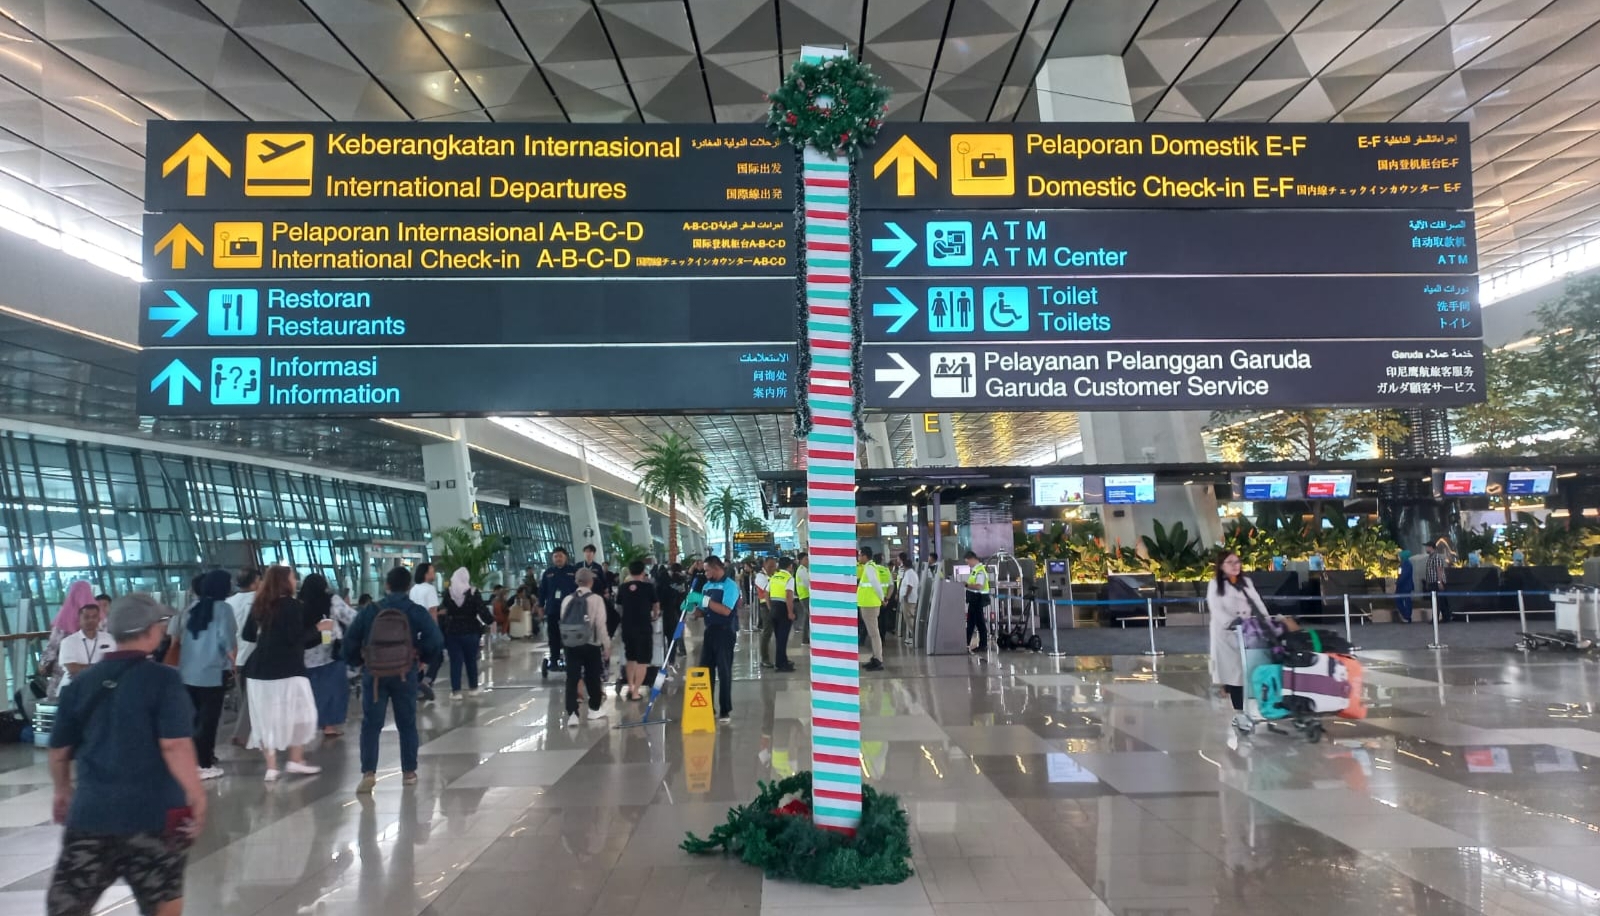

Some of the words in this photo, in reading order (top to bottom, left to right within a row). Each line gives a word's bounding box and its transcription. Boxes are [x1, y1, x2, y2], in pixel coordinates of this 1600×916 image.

[328, 133, 514, 160] Keberangkatan
[525, 135, 680, 158] Internasional
[1027, 134, 1142, 159] Pelaporan
[1151, 134, 1259, 156] Domestik
[1266, 136, 1307, 156] E-F
[1358, 136, 1381, 148] E-F
[737, 163, 781, 174] 国际出发
[327, 175, 480, 197] International
[490, 177, 626, 203] Departures
[727, 188, 782, 200] 国際線出発
[1028, 176, 1136, 196] Domestic
[1143, 176, 1245, 197] Check-in
[1253, 177, 1294, 197] E-F
[1444, 183, 1461, 192] E-F
[272, 222, 389, 246] Pelaporan
[399, 222, 543, 242] Internasional
[550, 221, 643, 241] A-B-C-D
[683, 221, 718, 231] A-B-C-D
[1412, 236, 1466, 247] 自动取款机
[272, 249, 412, 268] International
[421, 249, 519, 268] Check-in
[536, 248, 630, 268] A-B-C-D
[1054, 247, 1127, 266] Center
[268, 289, 370, 308] Restoran
[1037, 286, 1098, 305] Toilet
[1437, 301, 1470, 312] 洗手间
[268, 316, 405, 336] Restaurants
[1038, 312, 1110, 331] Toilets
[1441, 318, 1470, 328] トイレ
[985, 352, 1099, 375] Pelayanan
[1107, 351, 1223, 374] Pelanggan
[1230, 349, 1312, 369] Garuda
[1392, 350, 1423, 359] Garuda
[270, 356, 376, 376] Informasi
[754, 370, 787, 381] 问询处
[270, 383, 399, 404] Information
[753, 387, 787, 398] 案内所
[986, 378, 1067, 397] Garuda
[1074, 377, 1181, 396] Customer
[1188, 376, 1269, 396] Service
[924, 413, 940, 433] E
